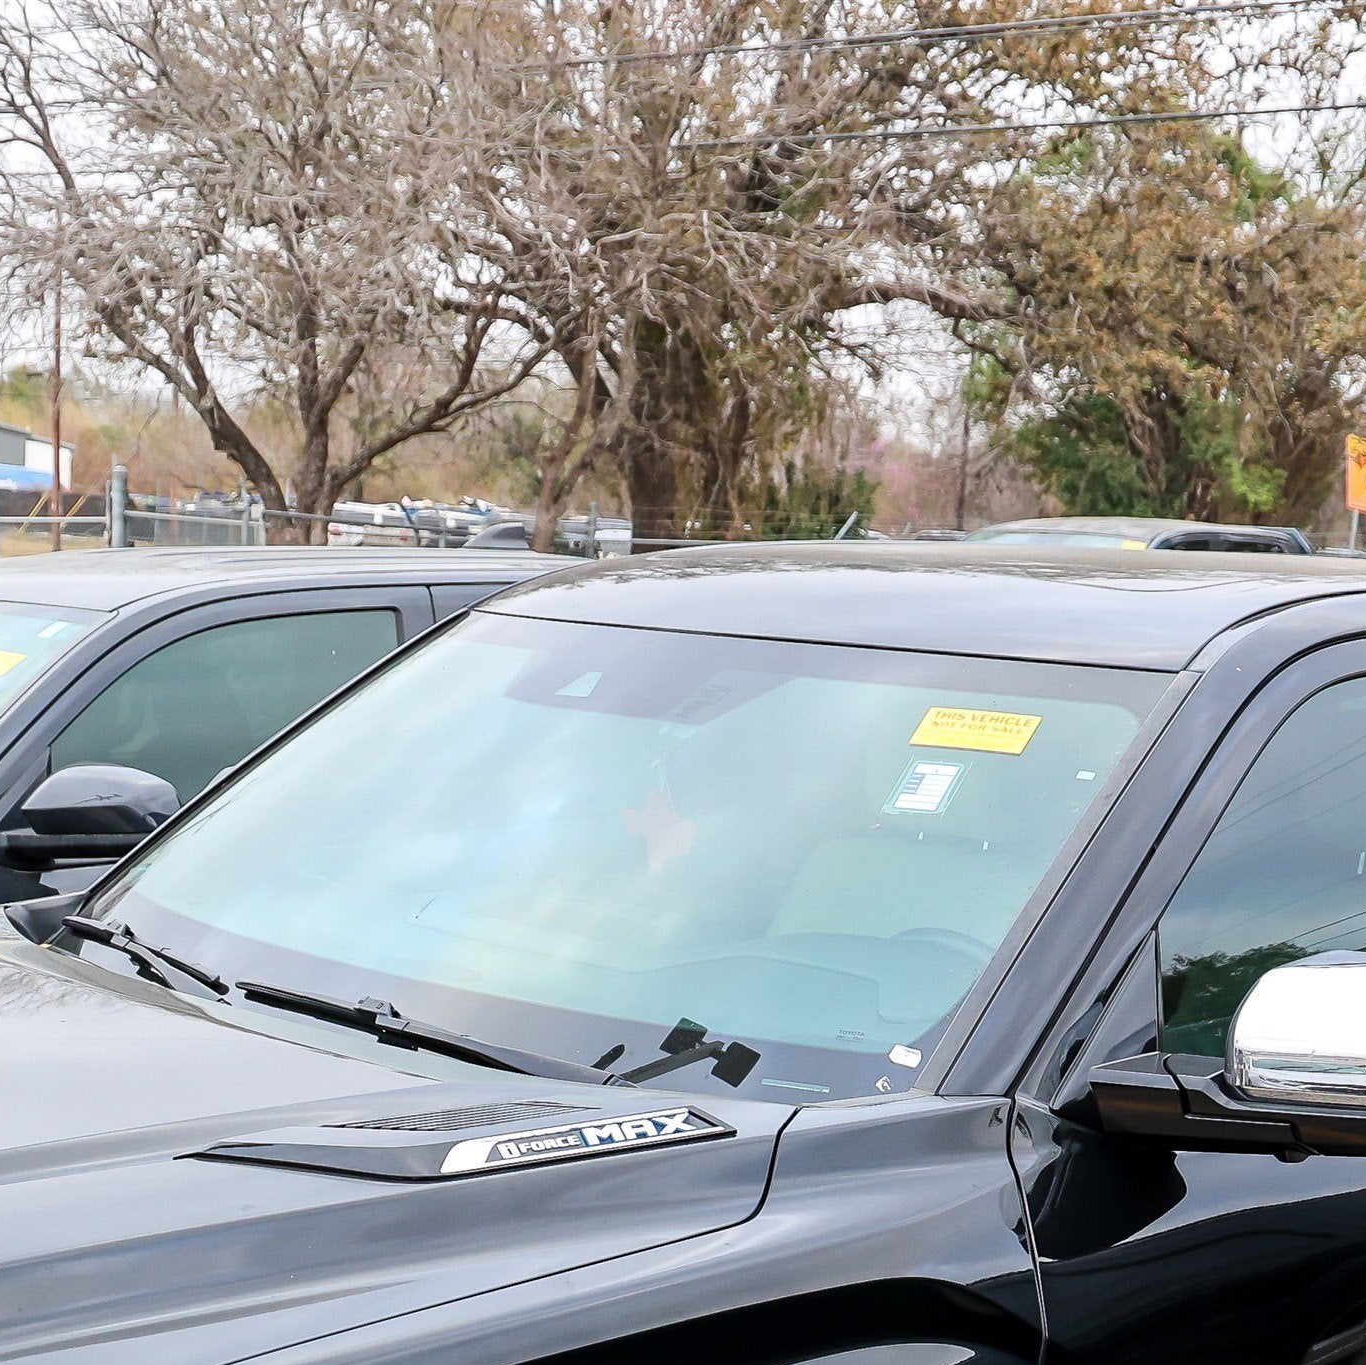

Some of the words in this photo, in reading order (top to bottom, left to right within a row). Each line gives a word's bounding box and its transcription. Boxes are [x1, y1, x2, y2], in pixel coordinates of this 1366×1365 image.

[934, 710, 966, 721] THIS
[971, 713, 1034, 728] VEHICLE
[931, 720, 956, 728] NOT
[960, 722, 986, 731] FOR
[991, 725, 1026, 735] SALE
[838, 1029, 866, 1037] TOYOTA
[583, 1111, 698, 1148] MAX
